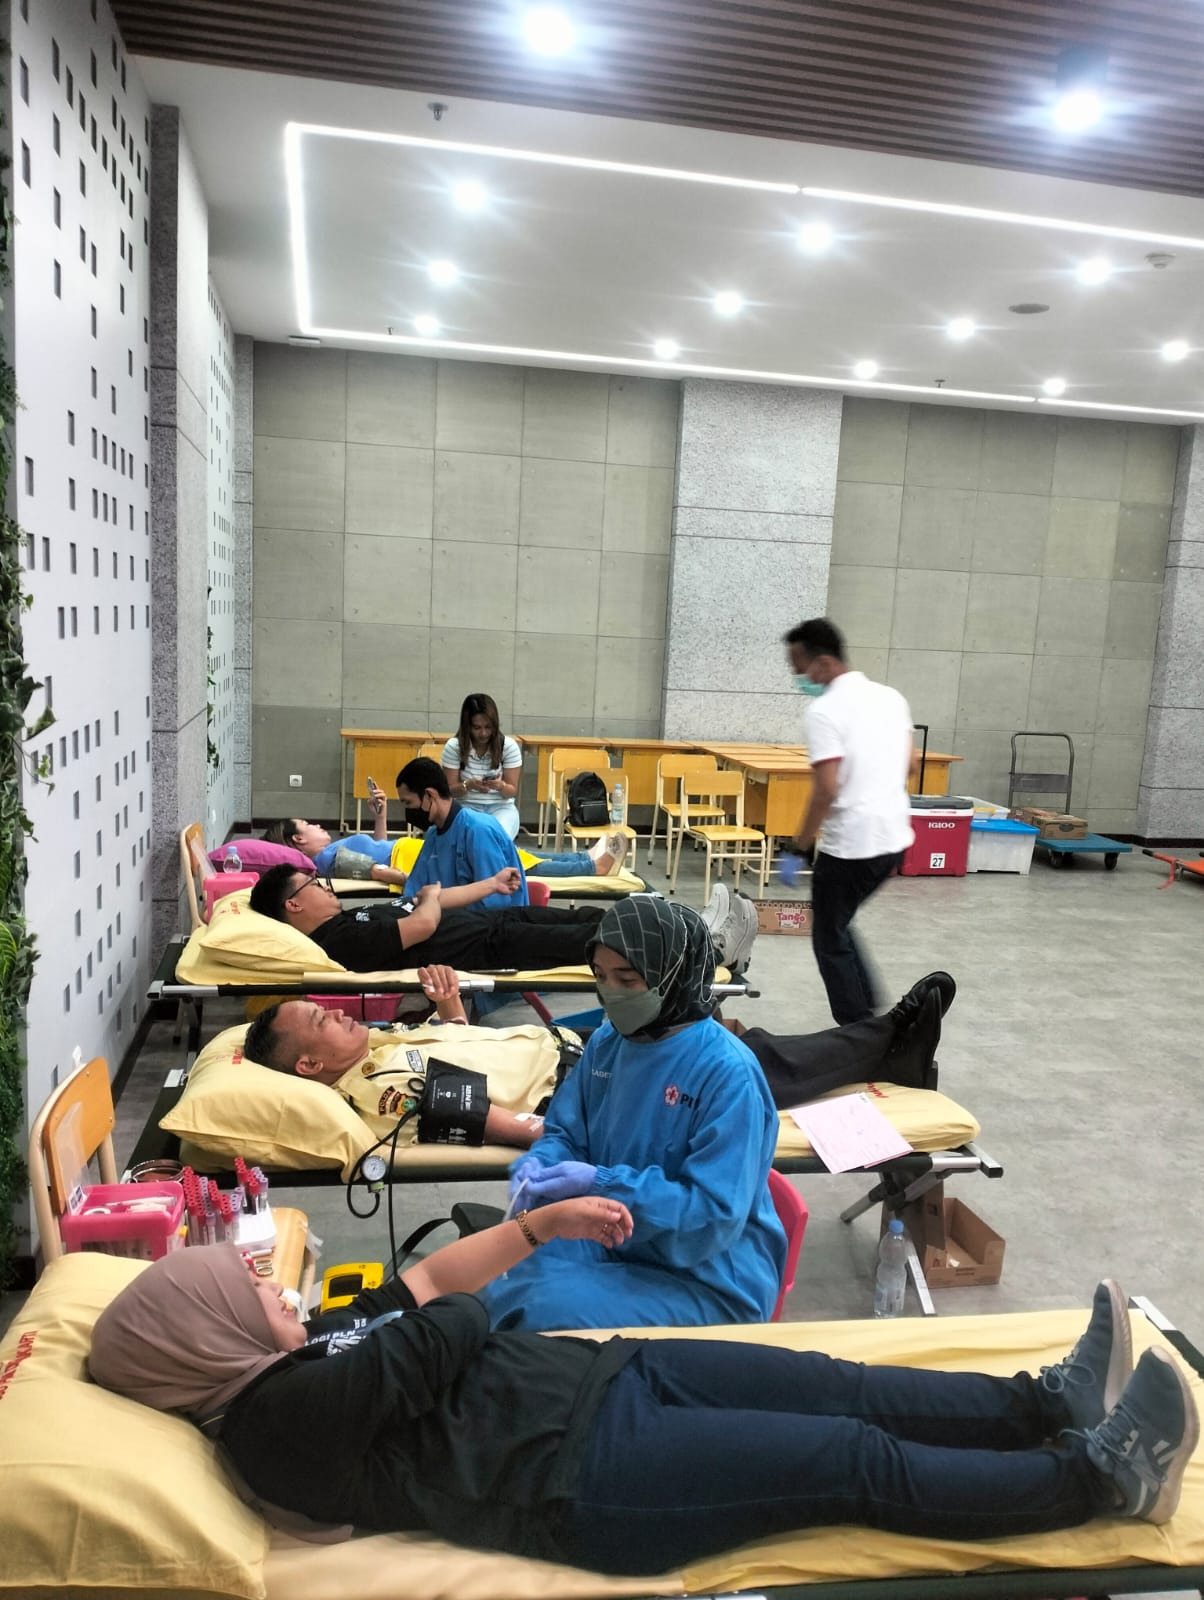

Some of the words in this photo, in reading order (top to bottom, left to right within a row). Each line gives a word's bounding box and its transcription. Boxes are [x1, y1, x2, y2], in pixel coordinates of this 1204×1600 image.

[932, 857, 945, 868] 27
[775, 912, 806, 925] Tango
[332, 1330, 356, 1339] PLN
